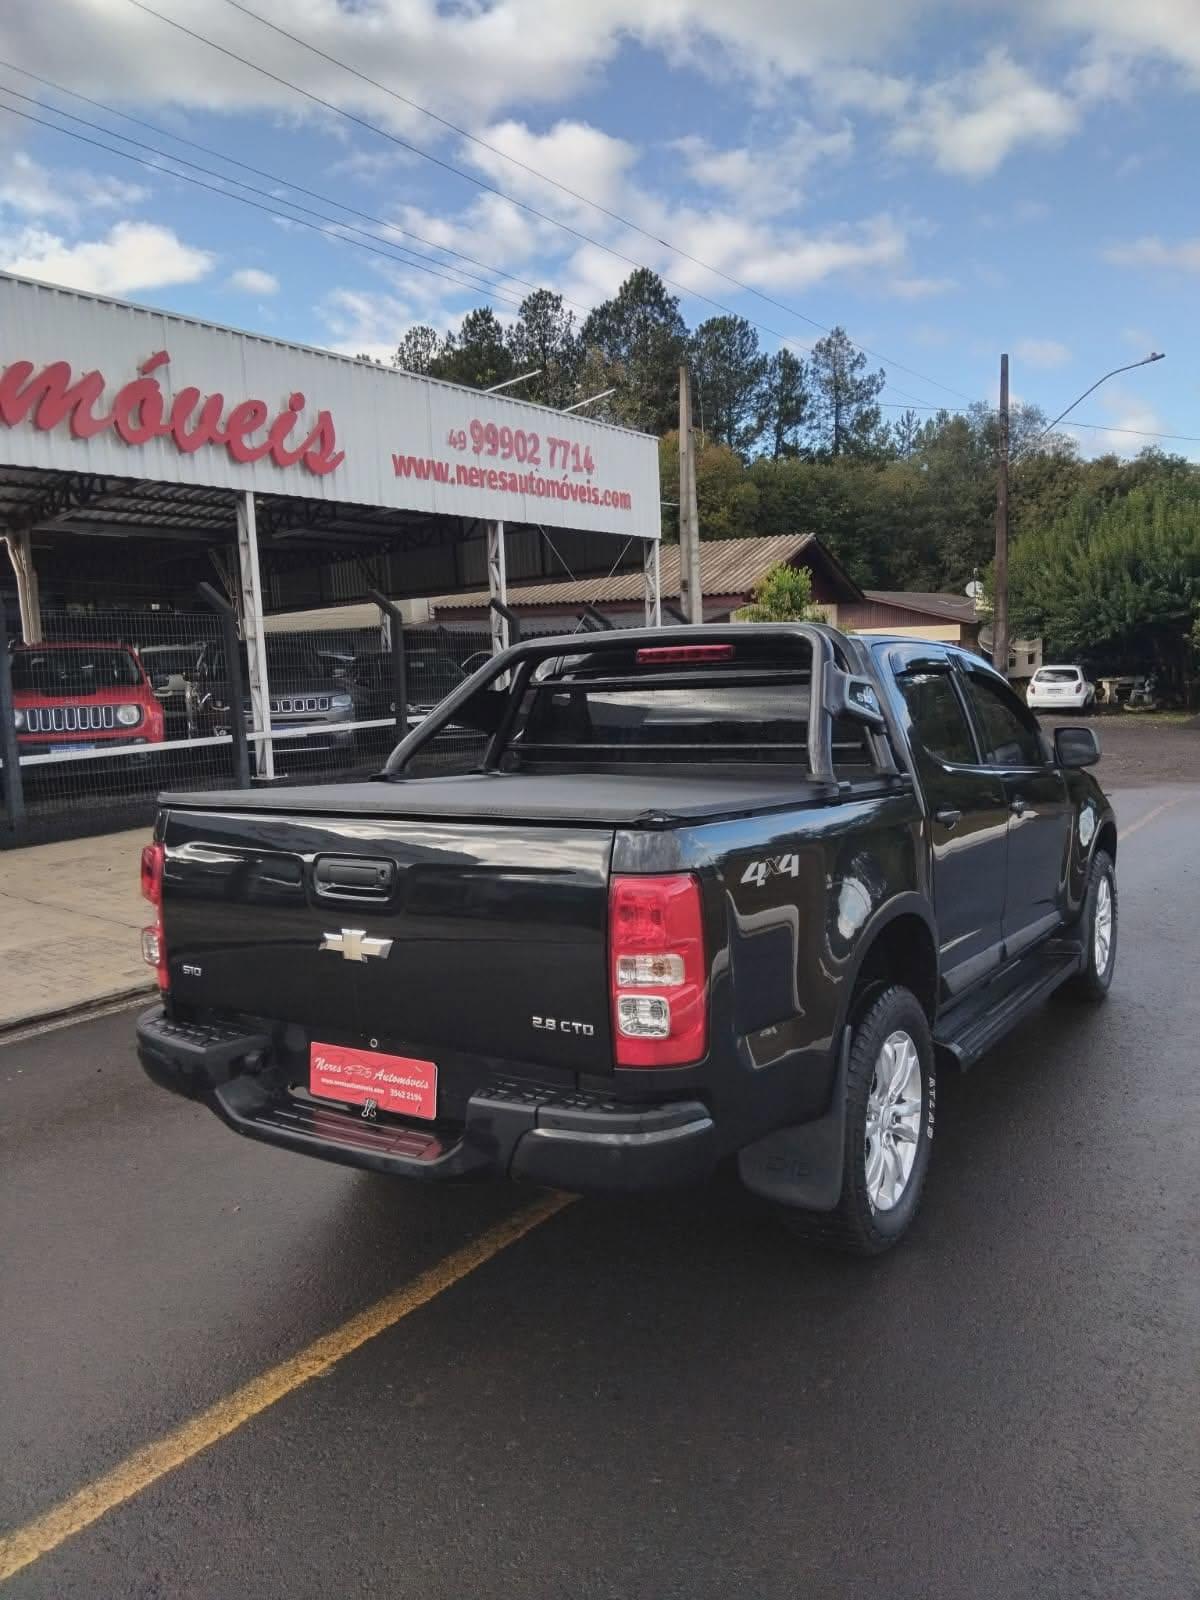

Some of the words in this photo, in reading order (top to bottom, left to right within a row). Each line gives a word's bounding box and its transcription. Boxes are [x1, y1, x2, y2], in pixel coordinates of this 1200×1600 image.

[448, 429, 467, 450] 49
[469, 419, 542, 465] 99902
[547, 437, 595, 474] 7714
[391, 453, 632, 510] www.neresautomóveis.com
[315, 1057, 341, 1072] Neres
[373, 1068, 429, 1089] Automóveis
